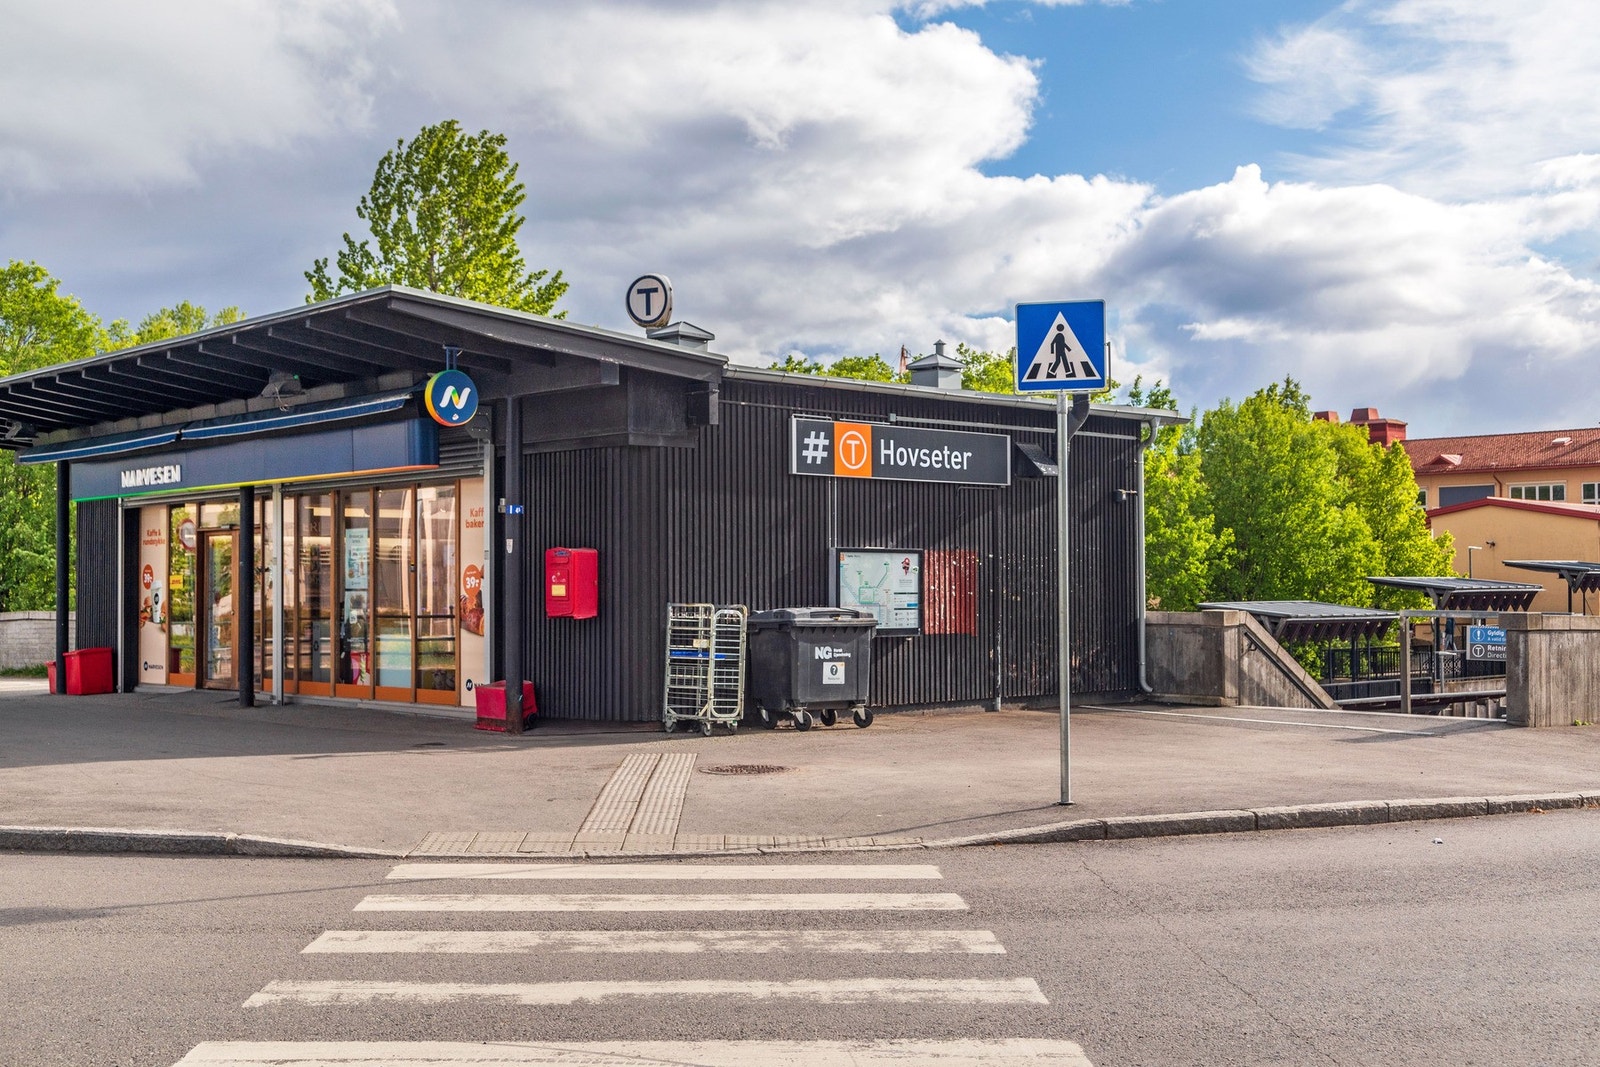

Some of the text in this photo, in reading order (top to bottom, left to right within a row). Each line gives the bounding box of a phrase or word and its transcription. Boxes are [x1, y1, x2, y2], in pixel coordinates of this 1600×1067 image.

[880, 438, 973, 470] Hovseter
[121, 465, 181, 488] NARVESEN
[465, 518, 484, 528] baker
[815, 646, 832, 660] NG
